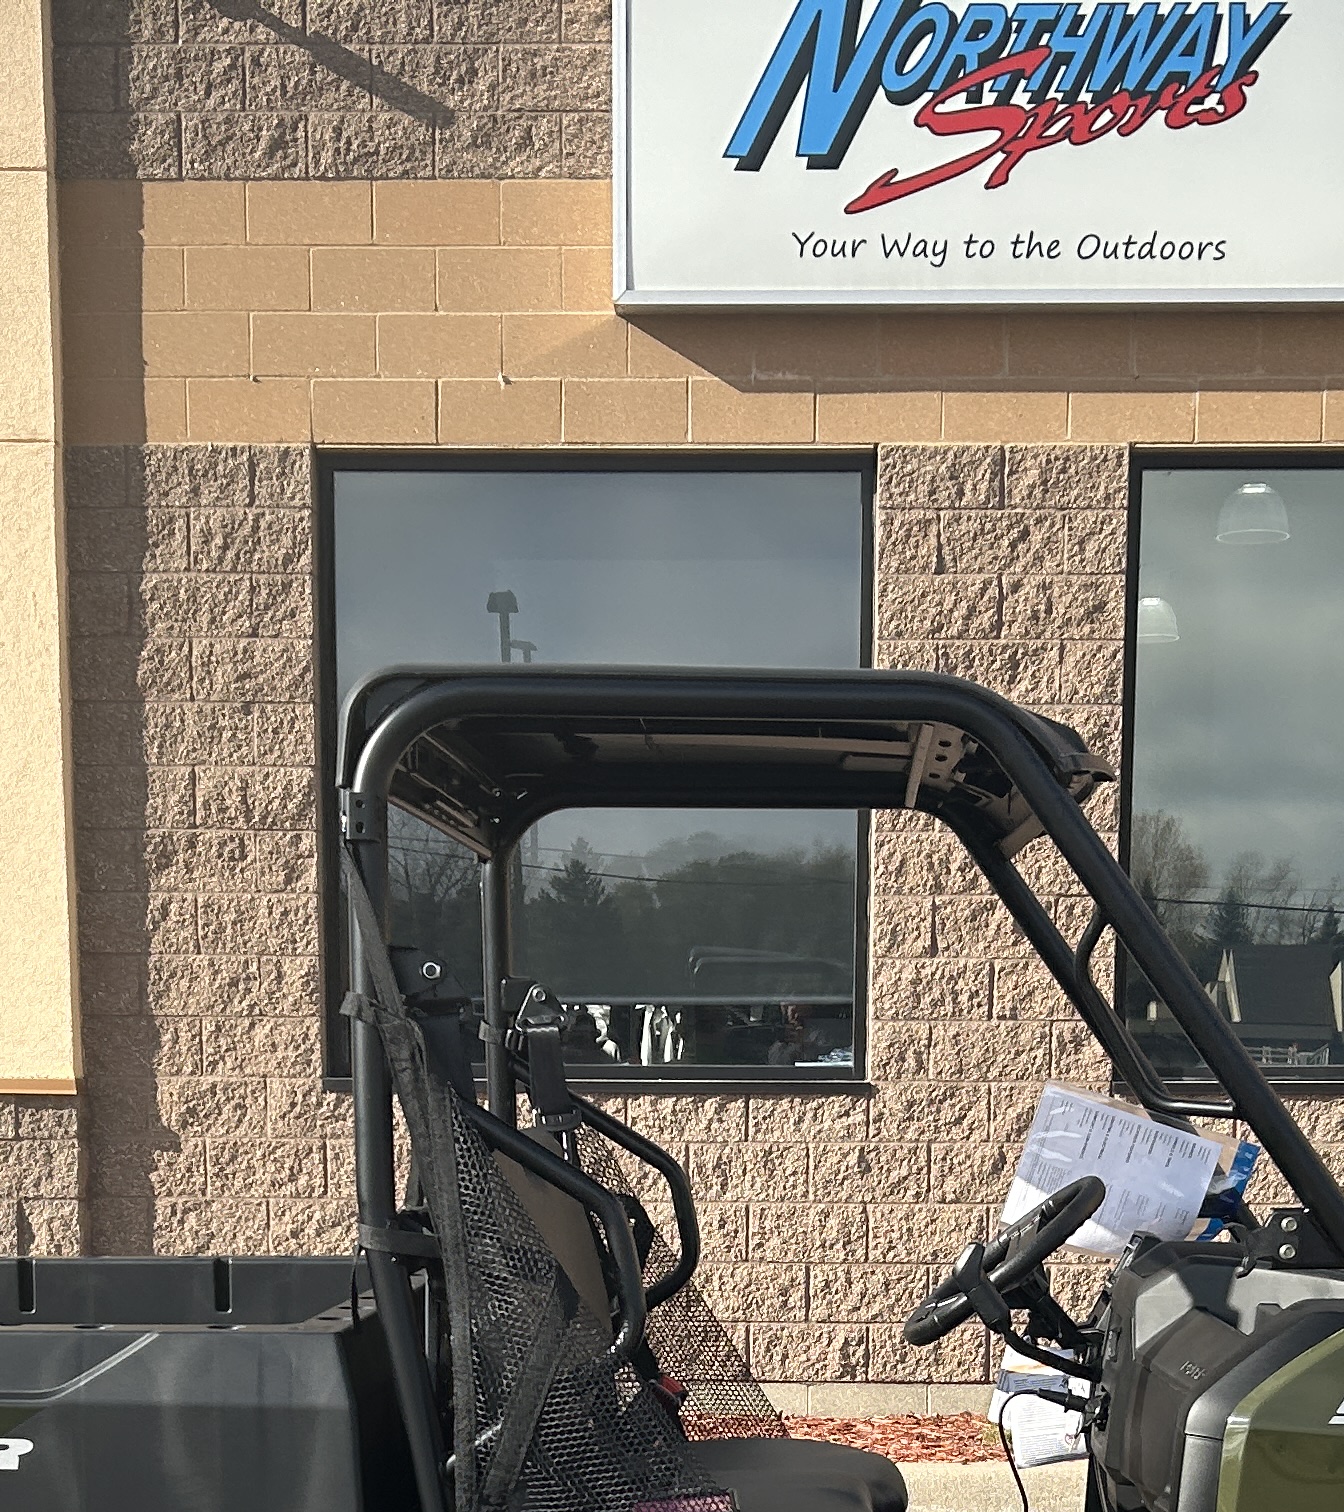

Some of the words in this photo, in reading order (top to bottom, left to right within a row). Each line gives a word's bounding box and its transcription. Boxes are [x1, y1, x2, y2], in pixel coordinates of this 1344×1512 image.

[723, 0, 1290, 170] NORTHWAY
[844, 45, 1259, 214] Sports
[792, 232, 867, 258] Your
[881, 232, 948, 267] Way
[963, 234, 995, 259] to
[1011, 231, 1061, 259] the
[1077, 231, 1227, 260] Outdoors
